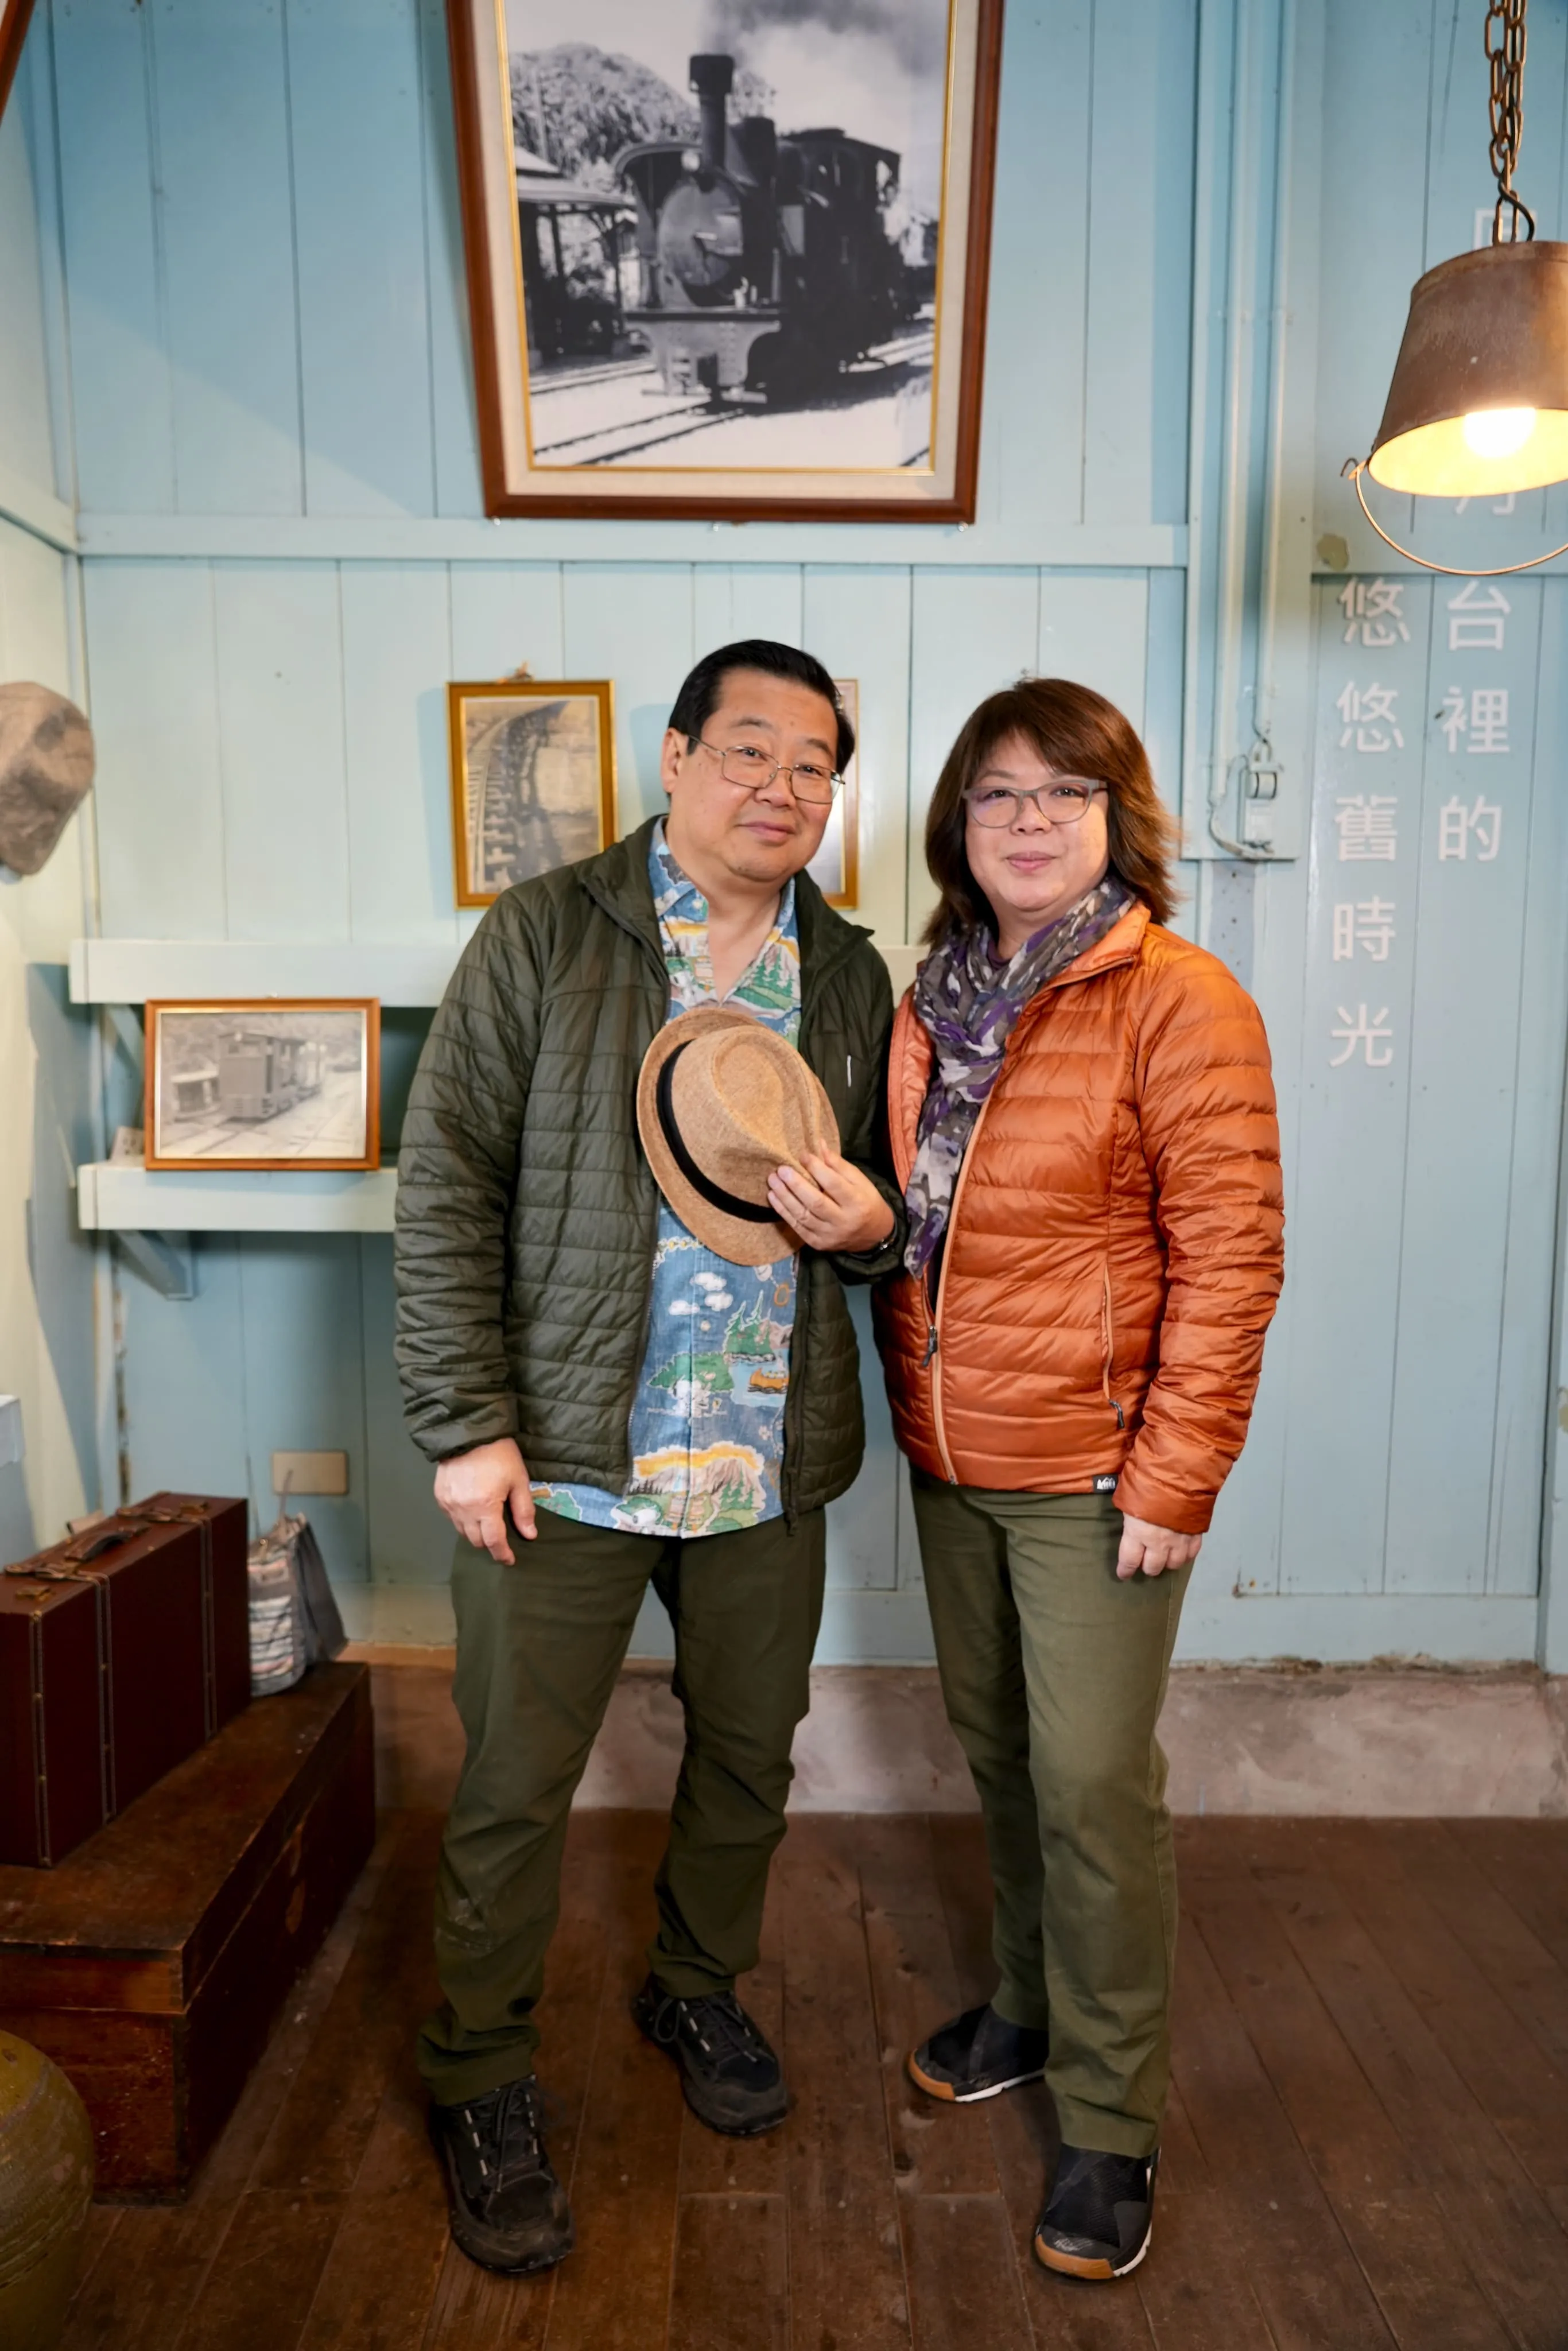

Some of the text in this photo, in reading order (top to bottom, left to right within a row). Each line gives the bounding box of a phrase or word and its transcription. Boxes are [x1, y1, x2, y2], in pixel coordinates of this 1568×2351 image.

[1329, 577, 1410, 1068] 悠悠舊時光
[1438, 495, 1516, 862] 台裡的
